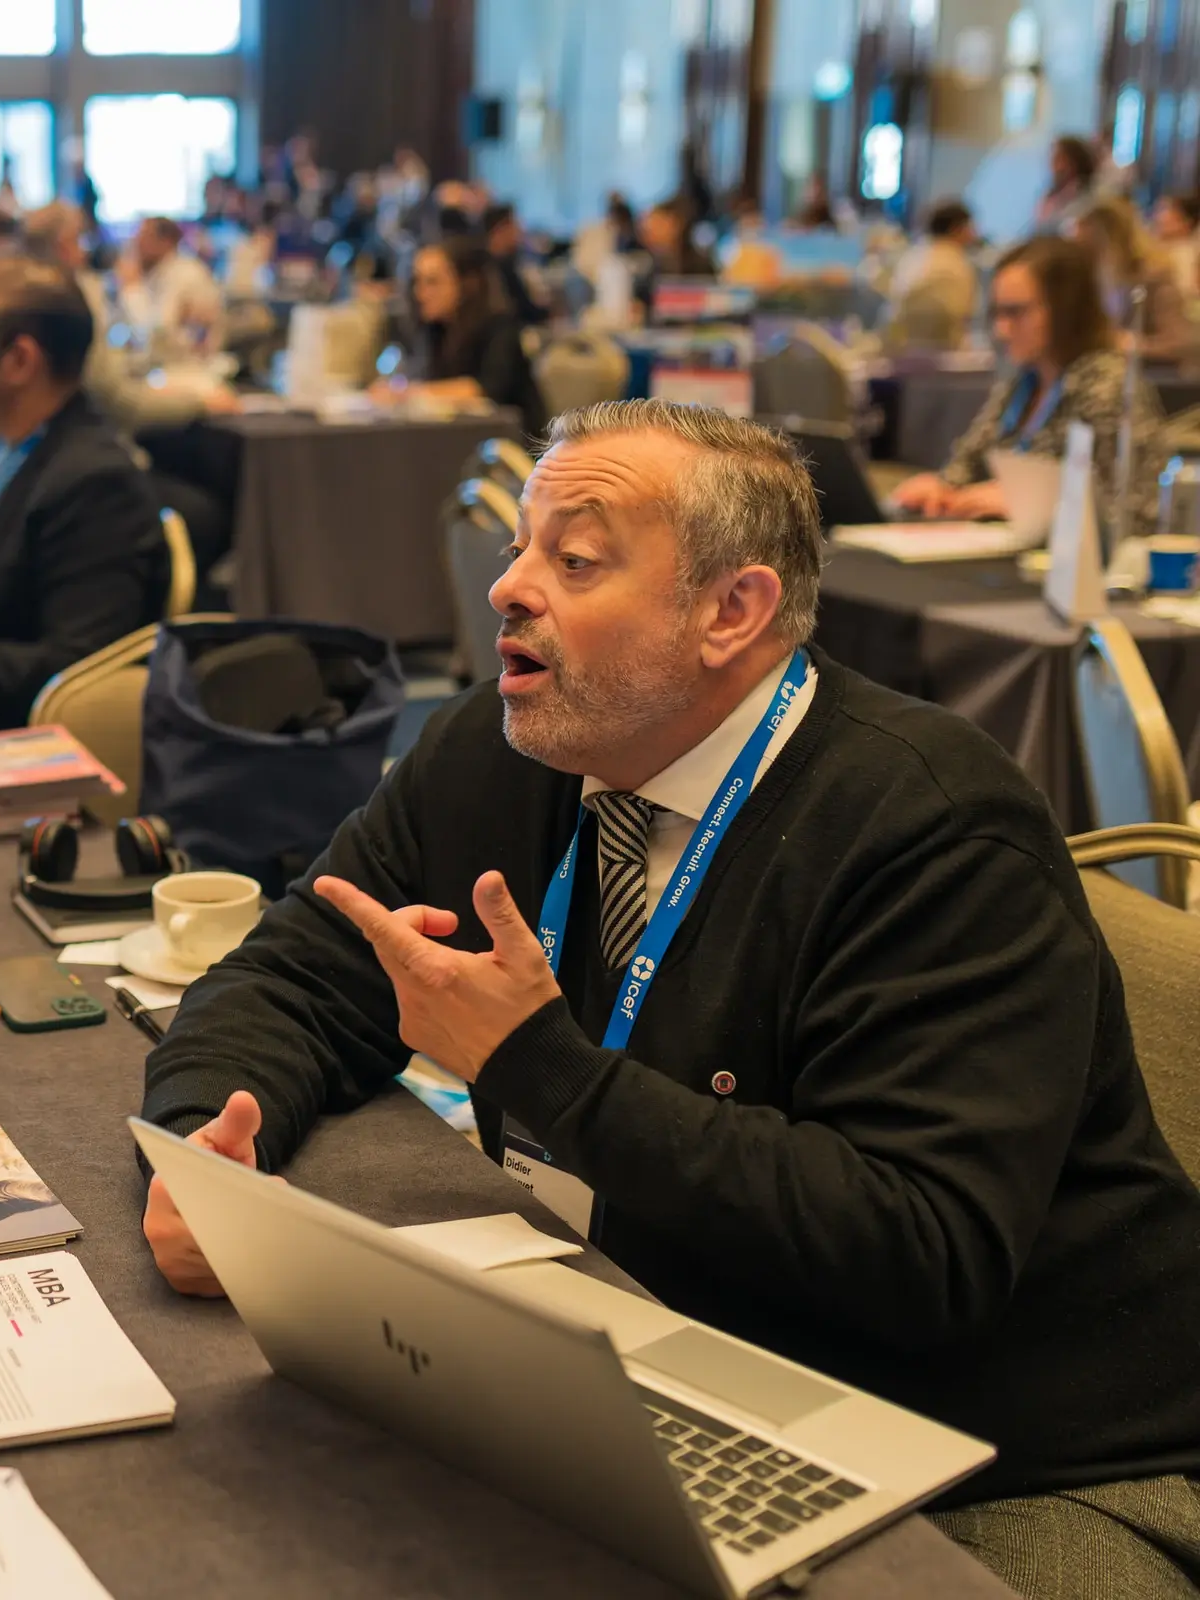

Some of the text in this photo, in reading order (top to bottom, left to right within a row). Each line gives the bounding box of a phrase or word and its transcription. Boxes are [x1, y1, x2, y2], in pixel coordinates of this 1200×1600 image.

[667, 778, 744, 908] Connect. Recruit. Grow.
[620, 980, 643, 1020] icef
[506, 1156, 531, 1176] Didier
[27, 1268, 71, 1307] MBA
